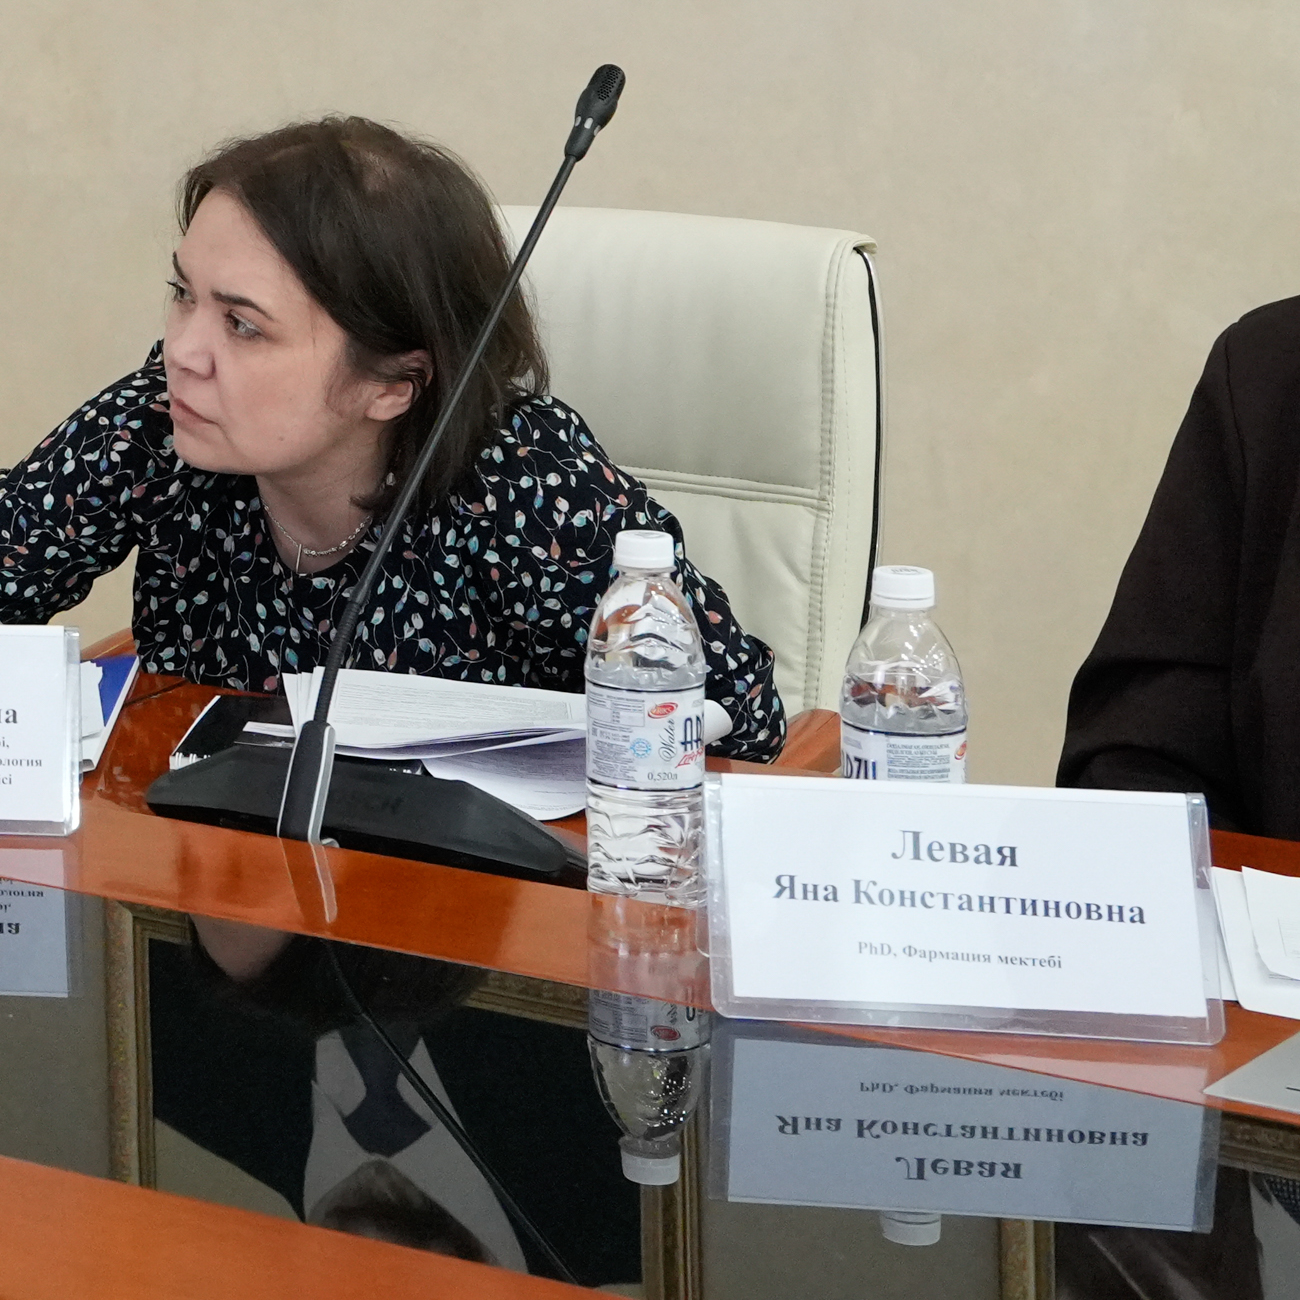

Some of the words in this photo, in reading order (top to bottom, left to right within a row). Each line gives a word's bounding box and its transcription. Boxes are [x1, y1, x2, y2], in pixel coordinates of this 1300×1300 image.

[891, 830, 1018, 868] Левая
[773, 874, 839, 903] Яна
[852, 879, 1146, 925] Константиновна
[858, 941, 898, 958] PhD,
[902, 944, 991, 964] Фармация
[997, 953, 1062, 970] мектебі
